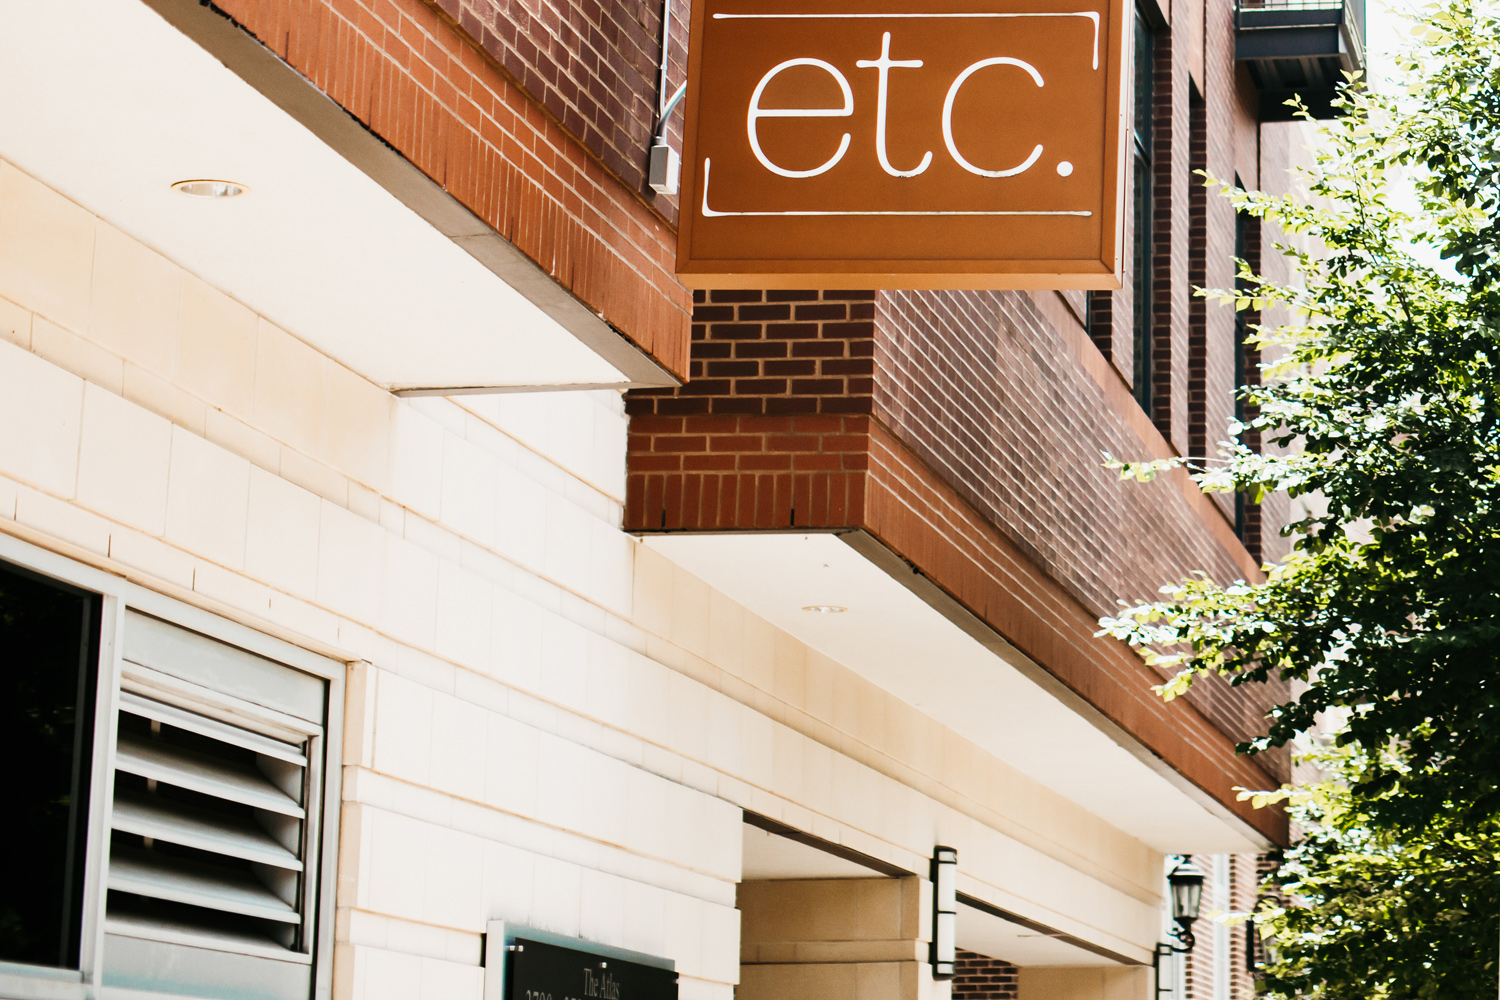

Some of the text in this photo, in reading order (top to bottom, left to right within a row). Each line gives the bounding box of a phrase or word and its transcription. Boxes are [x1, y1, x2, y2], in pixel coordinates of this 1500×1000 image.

[747, 31, 1074, 178] etc.
[583, 967, 620, 1000] The Atlas
